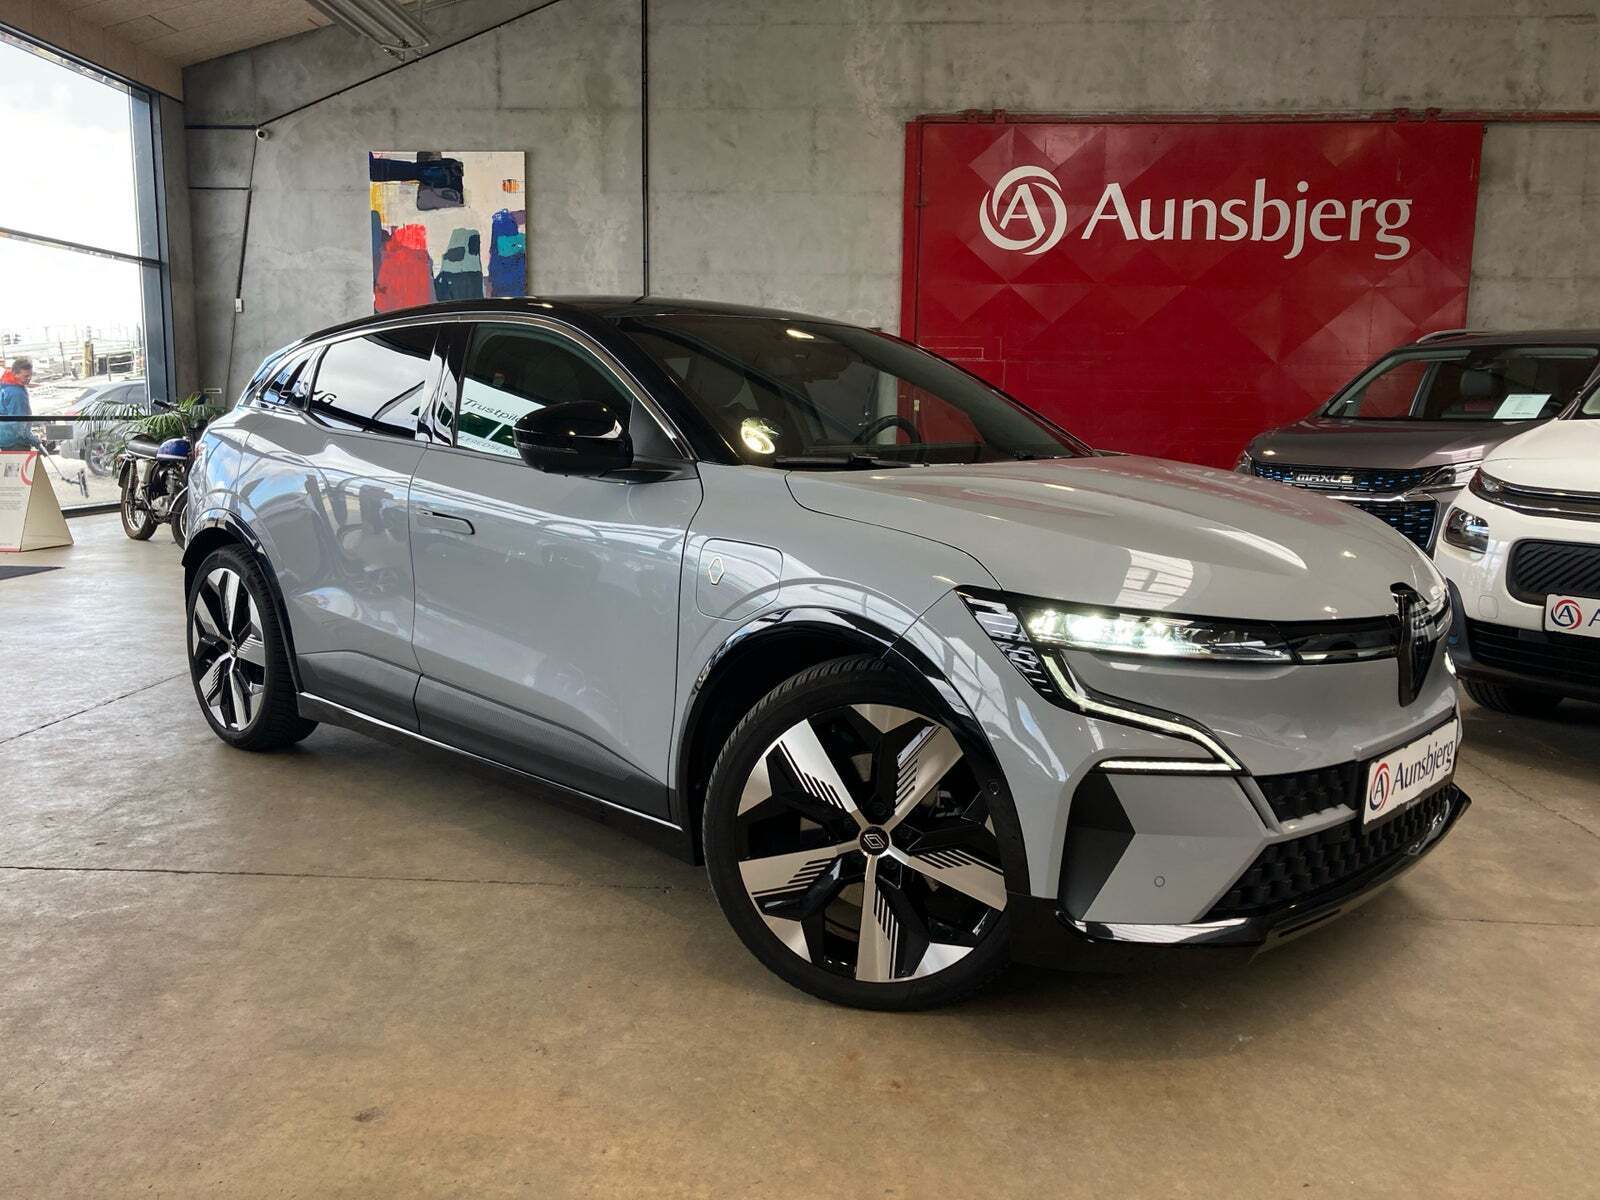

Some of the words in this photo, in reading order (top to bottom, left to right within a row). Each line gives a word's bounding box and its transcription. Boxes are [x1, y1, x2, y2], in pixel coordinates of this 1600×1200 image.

[1081, 178, 1412, 261] Aunsbjerg
[1296, 473, 1354, 484] MAXUS
[1392, 740, 1455, 796] Aunsbjerg
